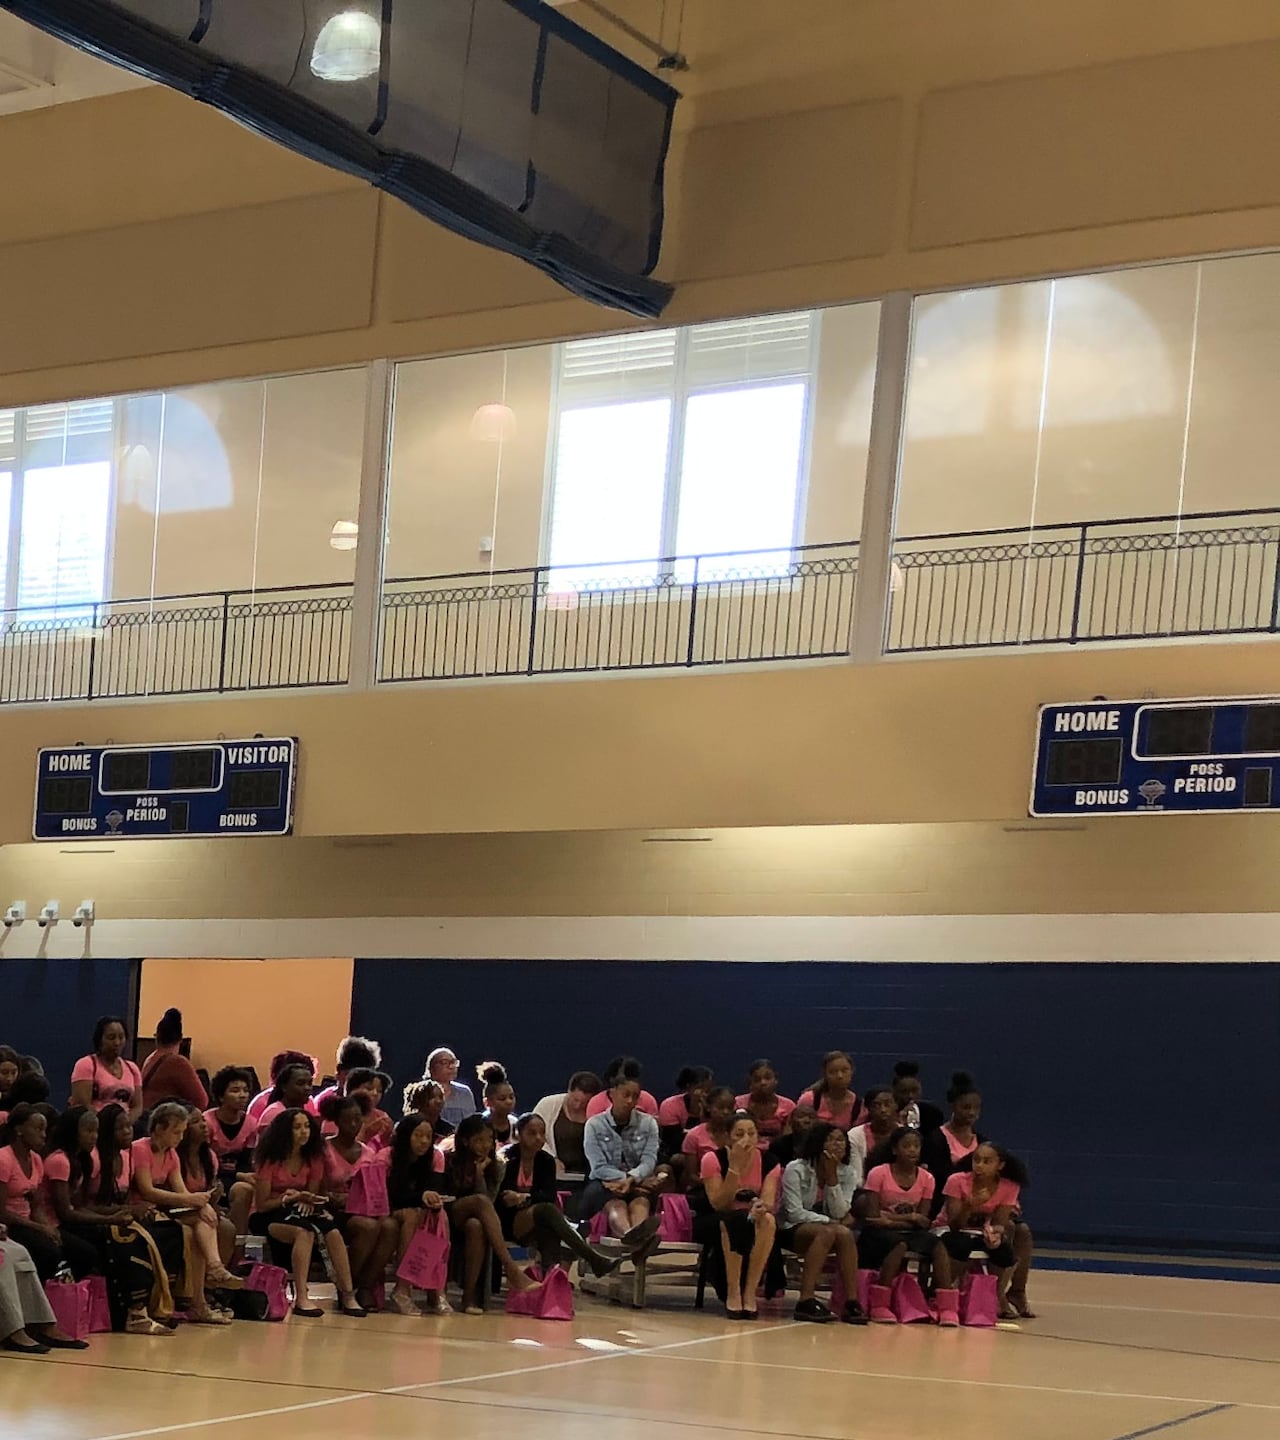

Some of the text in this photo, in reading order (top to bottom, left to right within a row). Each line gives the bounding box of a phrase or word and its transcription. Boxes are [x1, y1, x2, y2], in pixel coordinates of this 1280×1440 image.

[1054, 710, 1121, 733] HOME
[48, 753, 92, 772] HOME
[227, 745, 289, 765] VISITOR
[1189, 763, 1224, 775] POSS
[1173, 776, 1237, 794] PERIOD
[136, 796, 158, 807] POSS
[1074, 788, 1130, 806] BONUS
[126, 807, 167, 822] PERIOD
[219, 813, 258, 827] BONUS
[61, 817, 98, 831] BONUS
